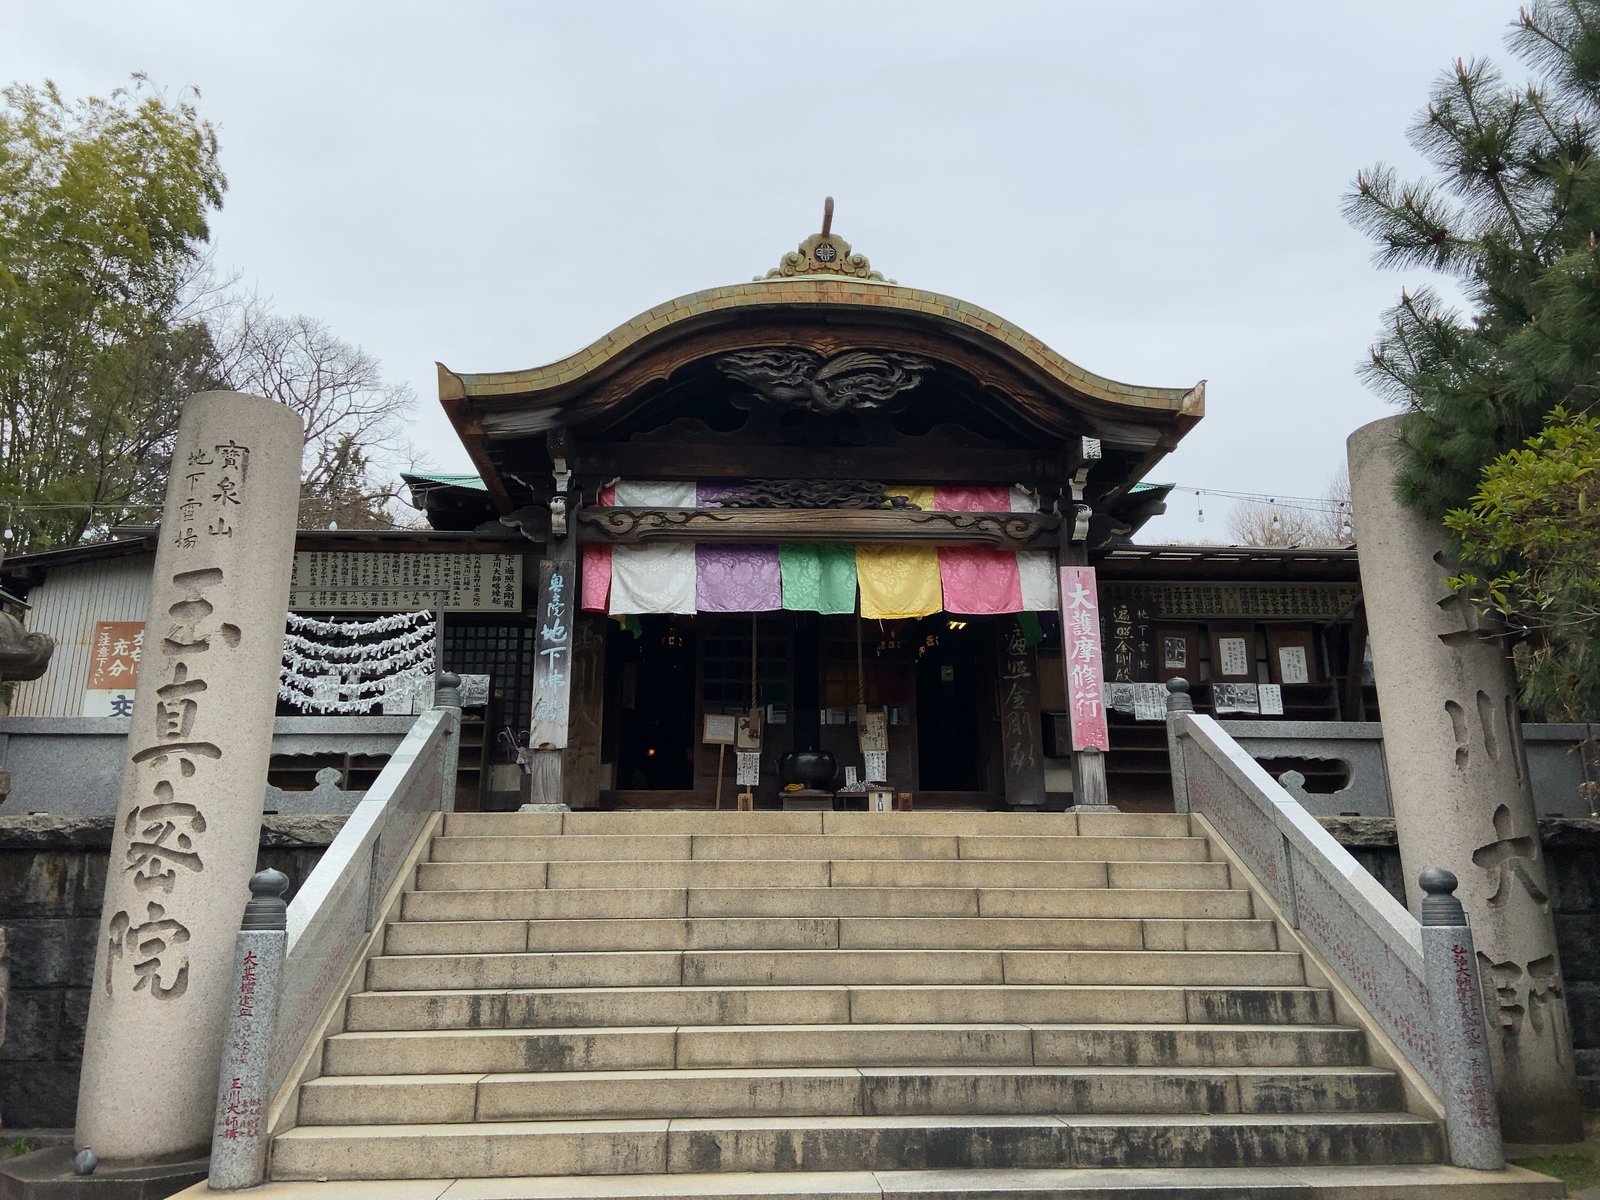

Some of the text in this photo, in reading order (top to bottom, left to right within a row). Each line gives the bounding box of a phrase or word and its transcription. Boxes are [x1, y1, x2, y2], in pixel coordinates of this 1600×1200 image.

[107, 638, 131, 677] 充分
[1068, 583, 1099, 718] 大護摩修行
[108, 567, 242, 1001] 玉真密院
